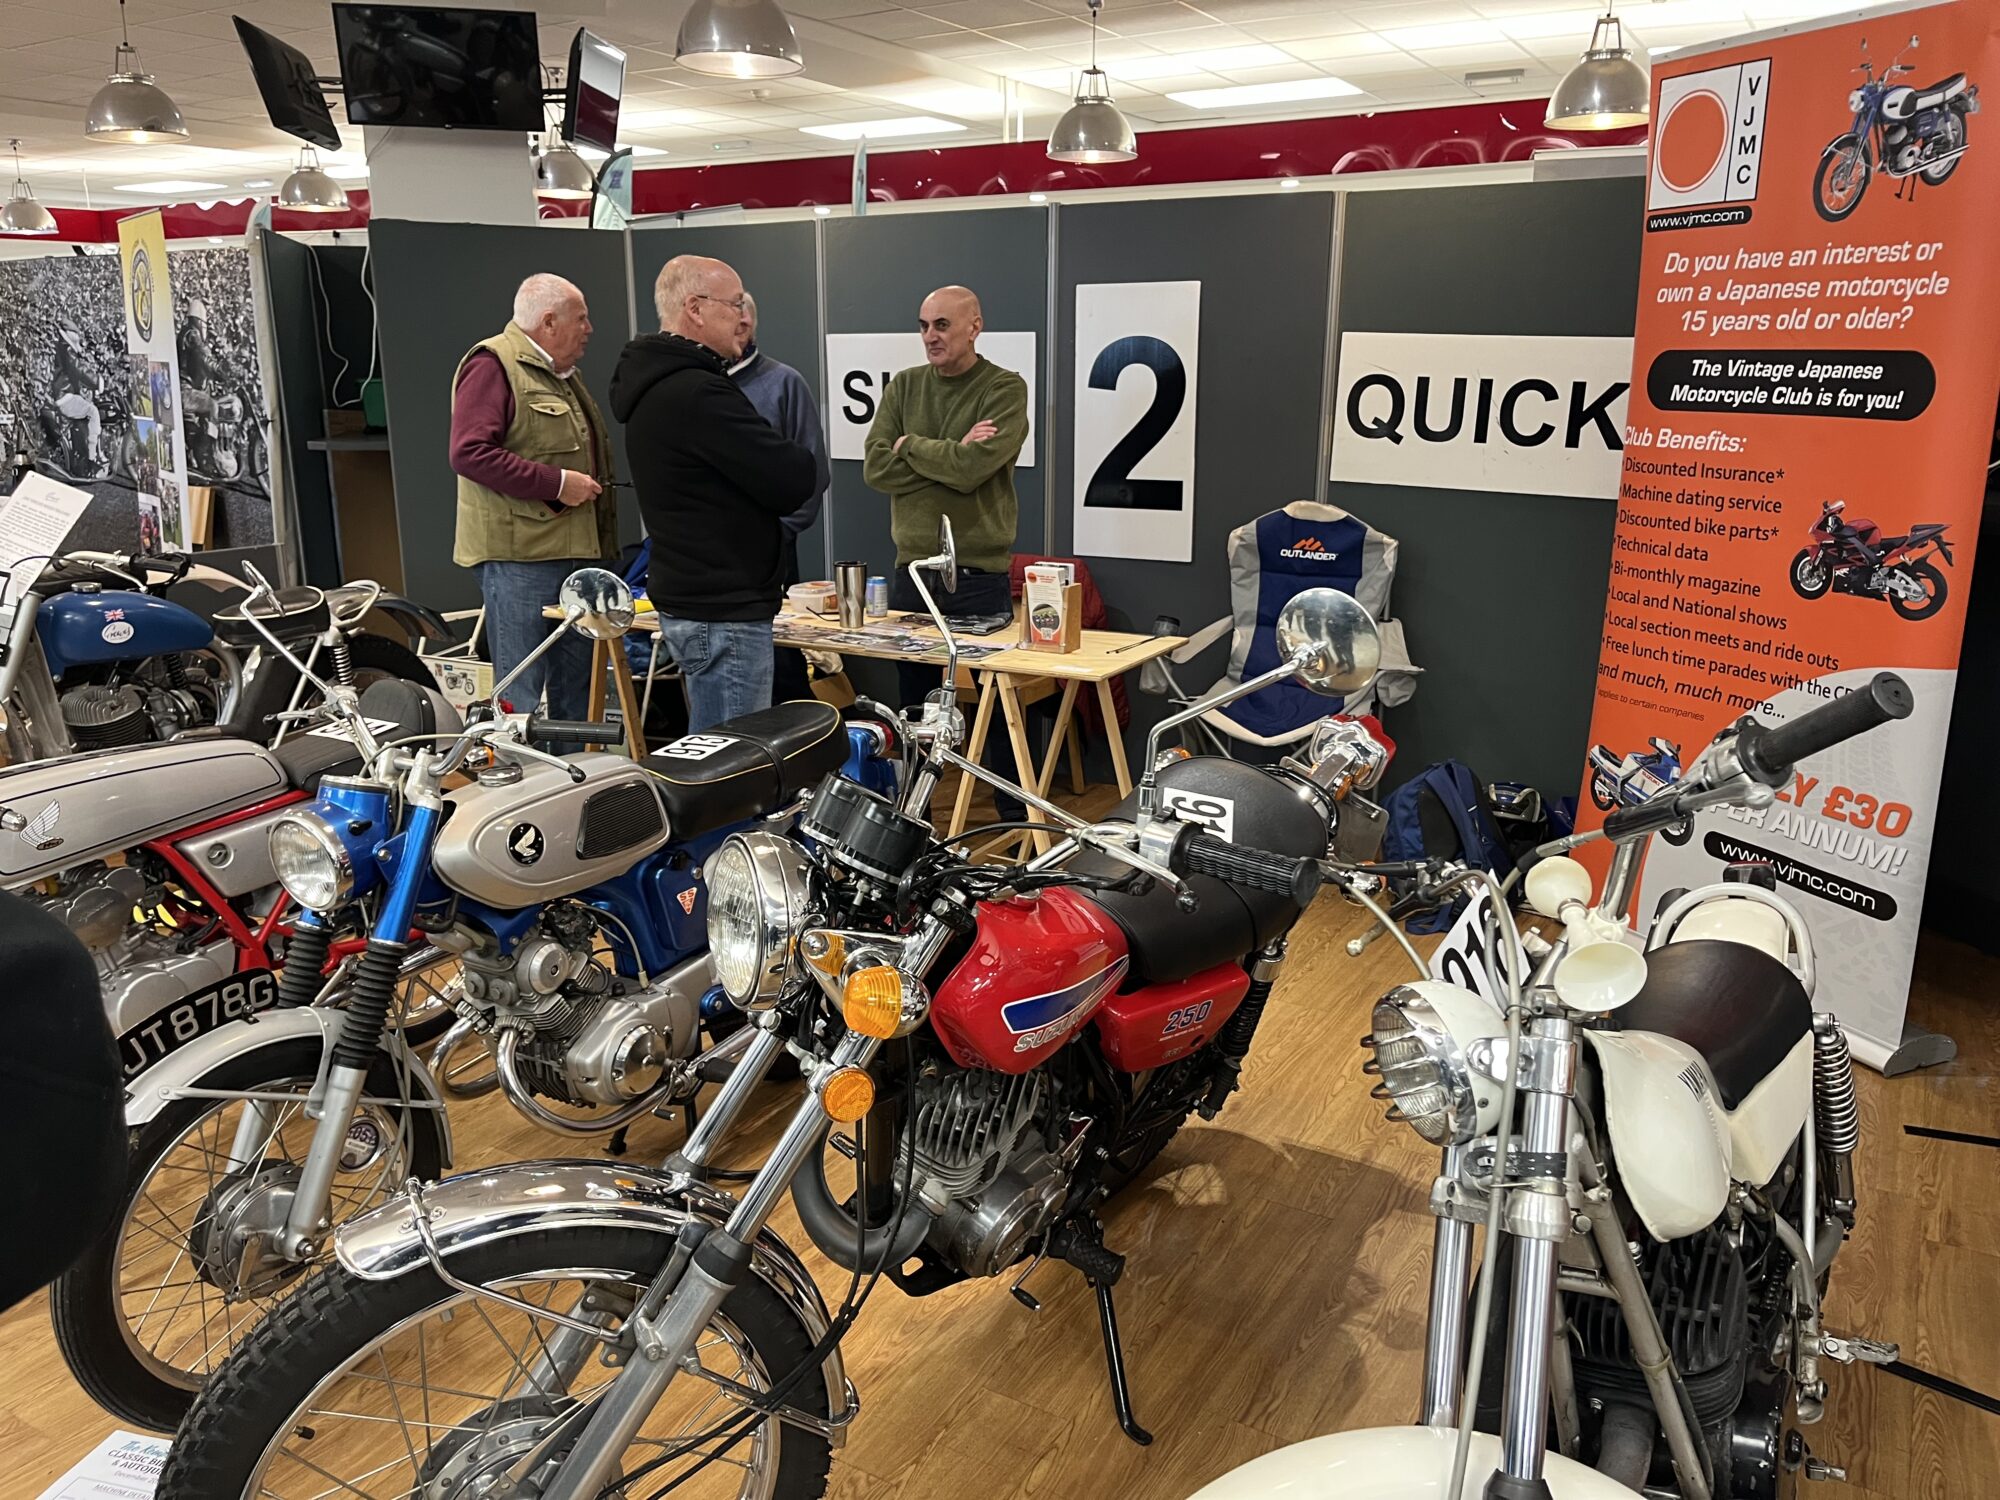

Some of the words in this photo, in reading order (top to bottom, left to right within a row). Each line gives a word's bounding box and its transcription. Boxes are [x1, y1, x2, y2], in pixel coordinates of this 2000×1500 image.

[1736, 75, 1762, 184] VJMC
[1649, 209, 1745, 229] www.vjmc.com
[1664, 252, 1688, 274] Do
[1692, 253, 1728, 277] you
[1735, 248, 1783, 270] have
[1788, 246, 1815, 267] an
[1822, 241, 1910, 266] interest
[1916, 241, 1943, 261] or
[1656, 284, 1694, 304] own
[1698, 283, 1711, 302] a
[1717, 278, 1820, 306] Japanese
[1826, 271, 1950, 302] motorcycle
[1680, 310, 1707, 332] 15
[1710, 312, 1770, 336] years
[1775, 308, 1811, 331] old
[1814, 309, 1840, 329] or
[1845, 305, 1914, 330] older?
[1691, 359, 1722, 378] The
[1727, 360, 1794, 383] Vintage
[1798, 361, 1884, 383] Japanese
[1347, 373, 1630, 450] QUICK
[1670, 384, 1768, 407] Motorcycle
[1772, 386, 1813, 406] Club
[1816, 387, 1832, 406] is
[1836, 388, 1863, 408] for
[1865, 390, 1904, 413] you!
[1084, 335, 1186, 511] 2
[1624, 426, 1652, 447] Club
[1656, 428, 1747, 453] Benefits:
[1625, 458, 1697, 477] Discounted
[1622, 484, 1672, 503] Machine
[1675, 488, 1725, 512] dating
[1728, 494, 1782, 513] service
[1619, 510, 1691, 533] Discounted
[1694, 516, 1726, 536] bike
[1280, 549, 1336, 560] OUTLANDER
[1617, 535, 1672, 557] Technical
[1674, 541, 1709, 561] data
[1614, 561, 1684, 588] Bi-monthly
[1688, 574, 1761, 597] magazine
[1611, 586, 1640, 605] Local
[1643, 593, 1669, 610] and
[1673, 597, 1736, 620] National
[1739, 609, 1787, 630] shows
[1608, 611, 1637, 630] Local
[1640, 618, 1691, 640] section
[1694, 627, 1739, 649] meets
[1743, 634, 1772, 655] and
[1775, 643, 1804, 662] ride
[1807, 651, 1839, 671] outs
[1606, 635, 1629, 654] Free
[1632, 640, 1669, 662] lunch
[1672, 649, 1706, 669] time
[1709, 660, 1767, 684] parades
[1770, 670, 1804, 692] with
[1807, 678, 1831, 699] the
[1599, 662, 1619, 679] and
[1621, 669, 1669, 693] much,
[1674, 681, 1722, 705] much
[1726, 692, 1786, 719] more...
[1620, 694, 1628, 703] to
[1629, 698, 1658, 711] certain
[1659, 705, 1705, 721] companies
[663, 736, 729, 756] 913
[1822, 786, 1912, 838] £30
[1769, 809, 1908, 876] ANNUM!
[1162, 1000, 1214, 1034] 250
[108, 1449, 149, 1464] CLASSIC
